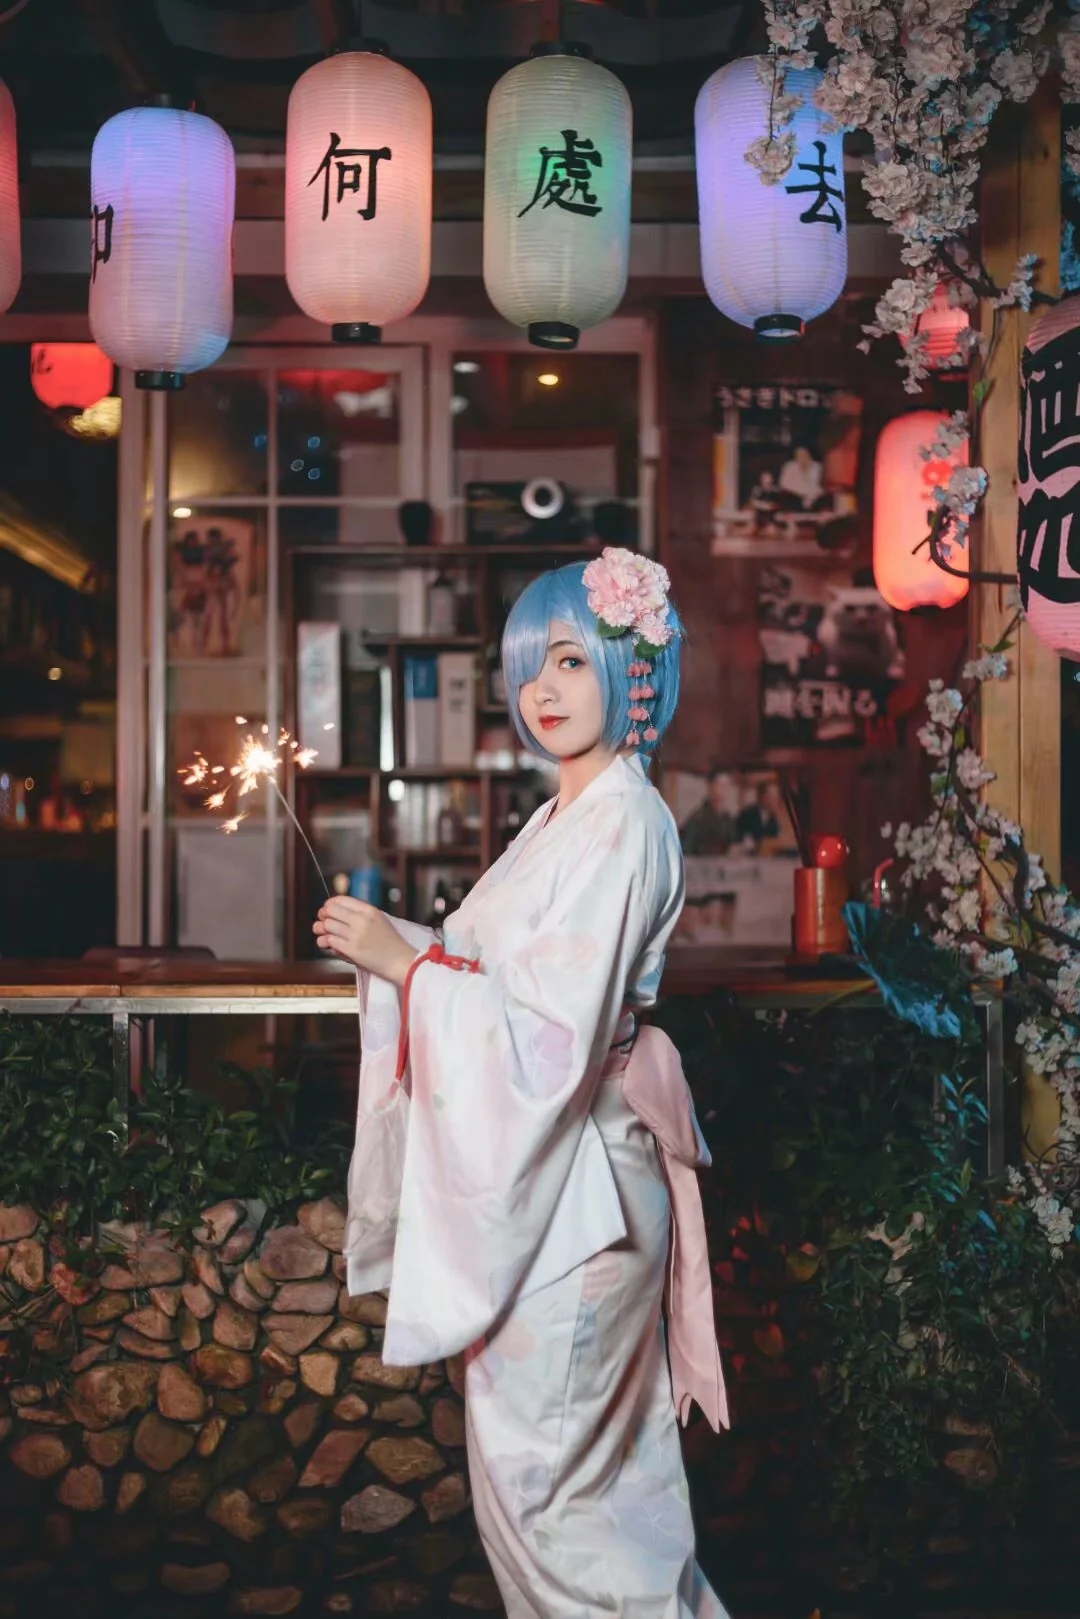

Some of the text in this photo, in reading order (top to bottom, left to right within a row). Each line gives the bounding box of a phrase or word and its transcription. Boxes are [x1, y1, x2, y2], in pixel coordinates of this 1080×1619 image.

[307, 131, 392, 222] 何
[517, 129, 603, 218] 處
[786, 141, 844, 233] 去
